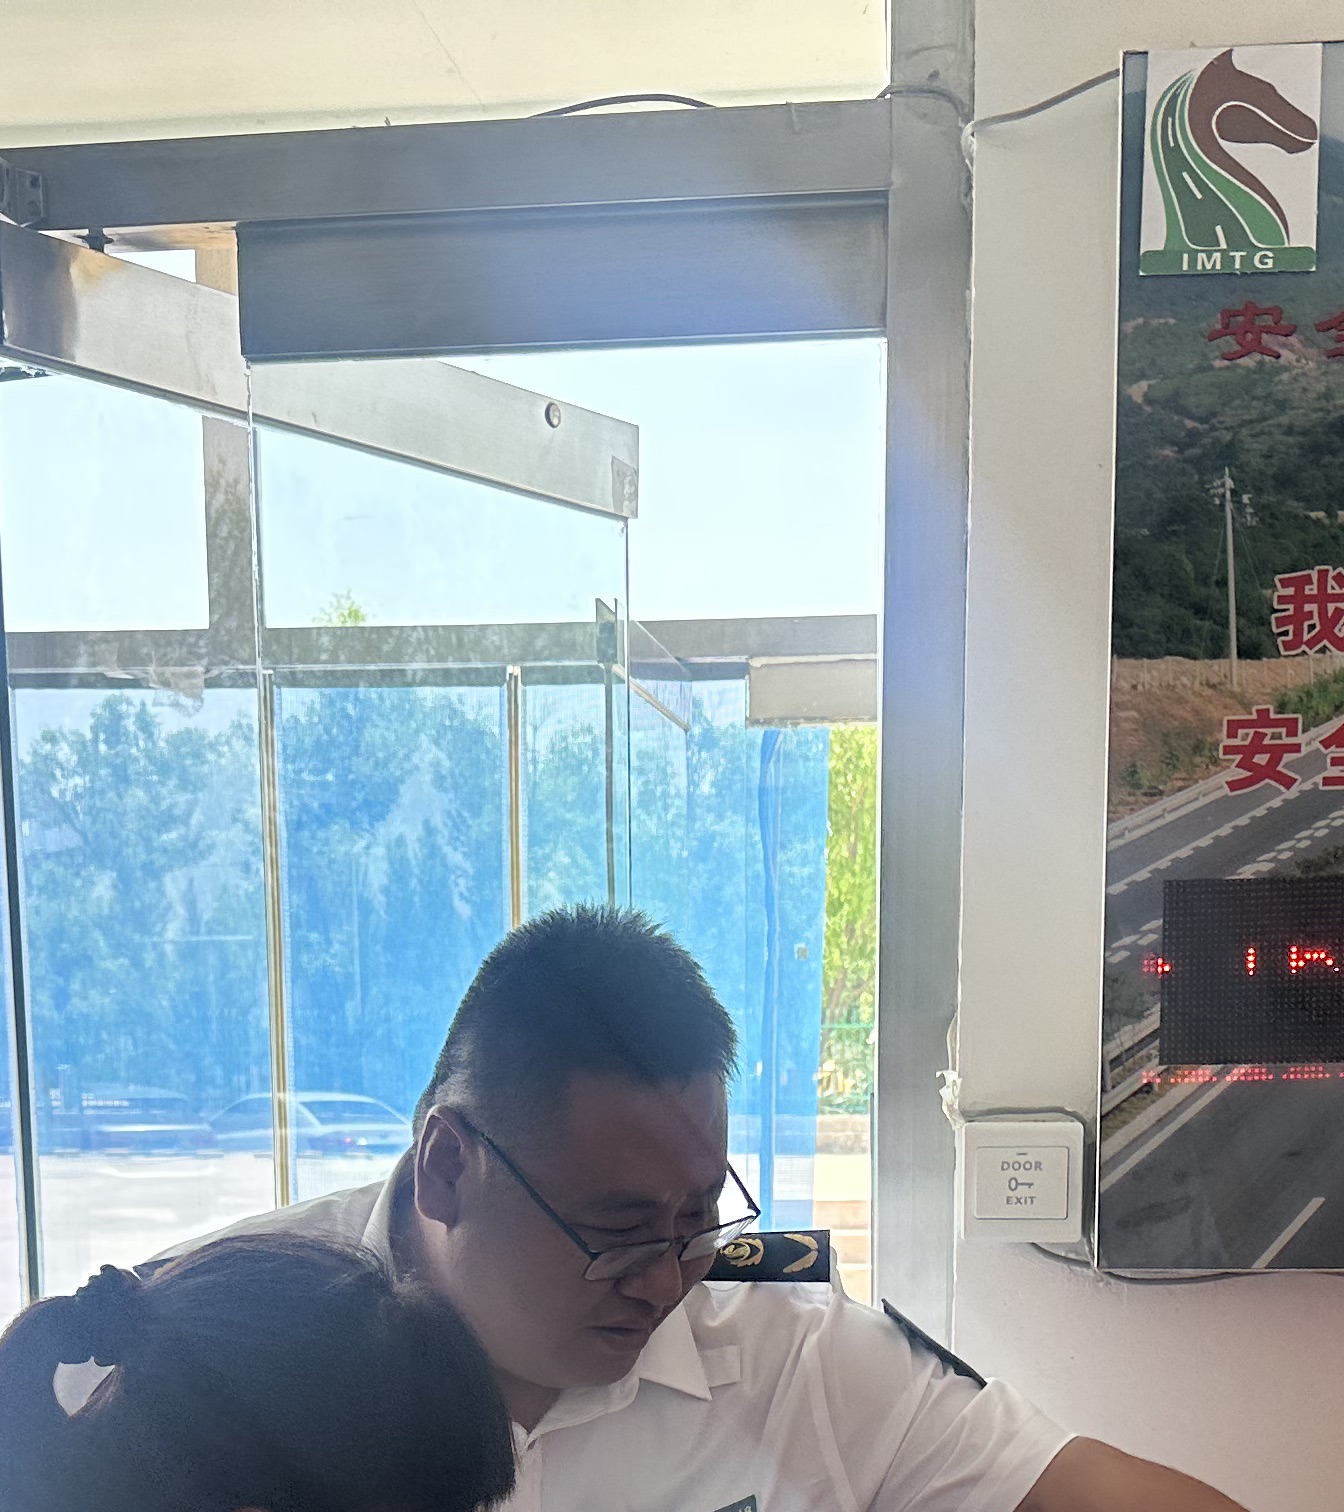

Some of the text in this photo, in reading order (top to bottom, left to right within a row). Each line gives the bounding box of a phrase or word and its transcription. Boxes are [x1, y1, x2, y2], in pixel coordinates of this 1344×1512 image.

[1180, 249, 1276, 271] IMTG
[1001, 1160, 1043, 1172] DOOR
[1006, 1196, 1036, 1206] EXIT
